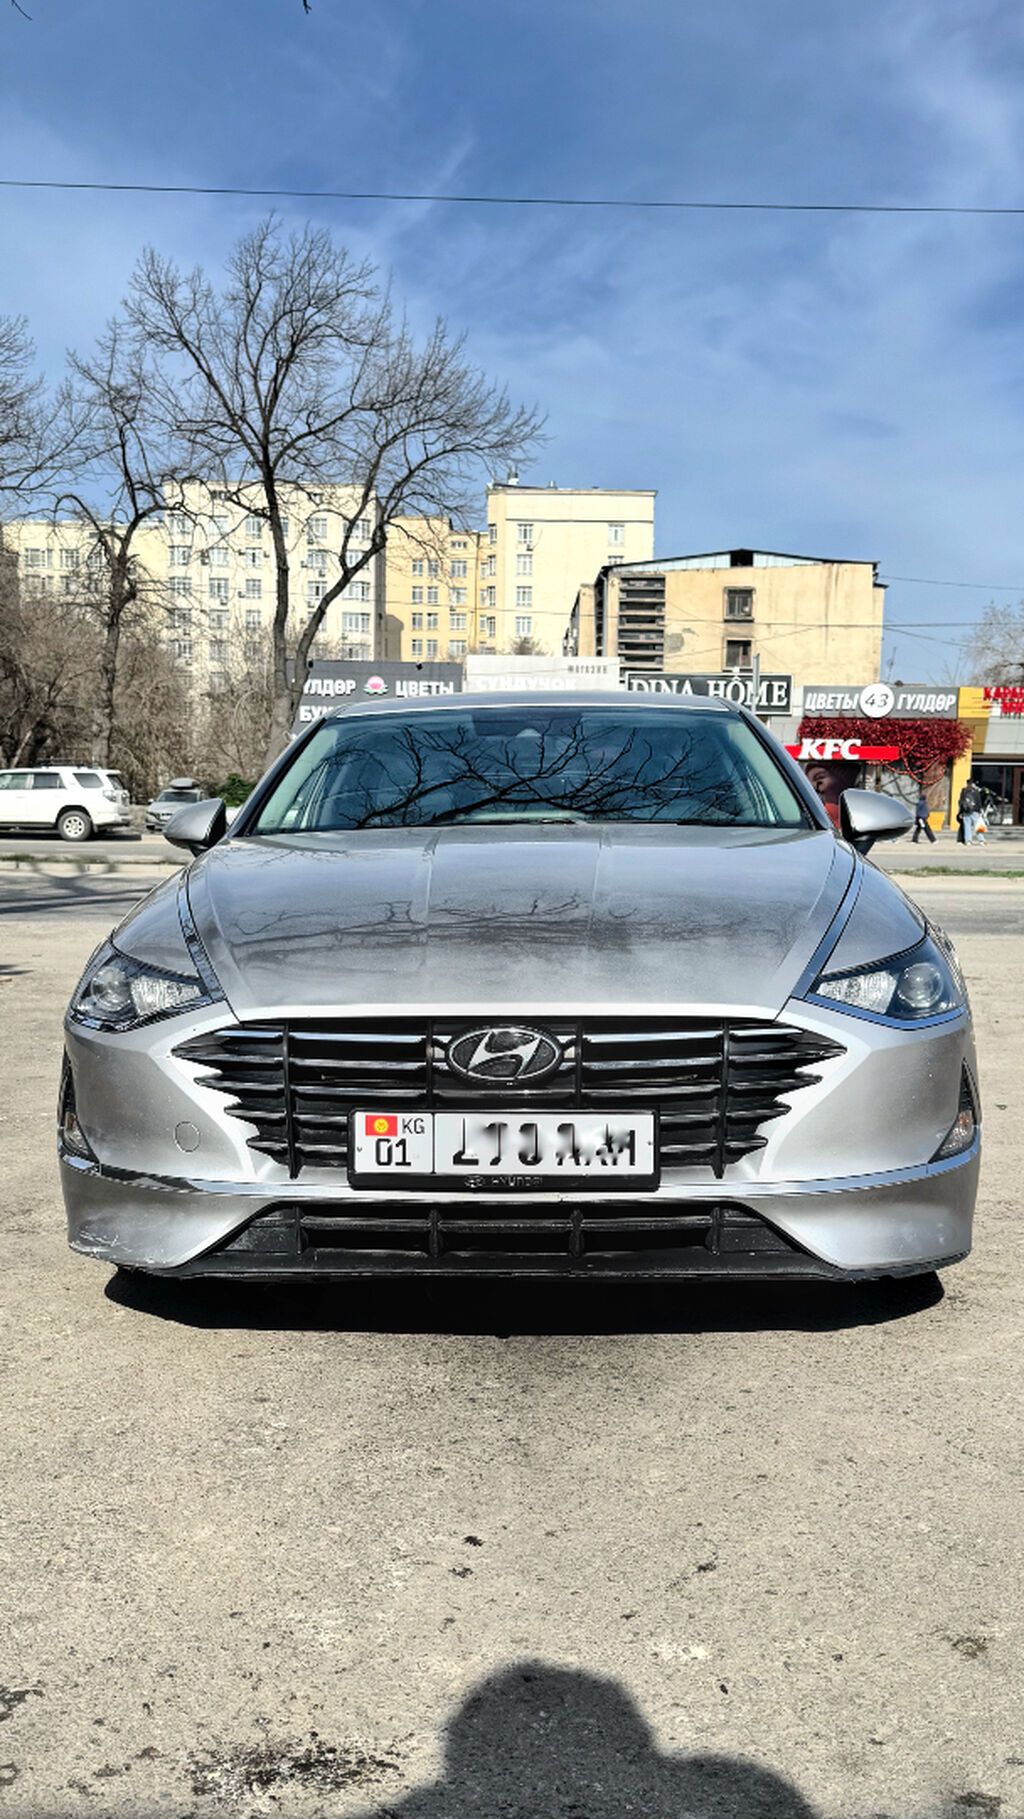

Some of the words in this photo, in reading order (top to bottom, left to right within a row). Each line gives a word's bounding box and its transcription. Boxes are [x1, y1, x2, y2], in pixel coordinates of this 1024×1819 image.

[395, 680, 455, 697] ЦВЕТЫ
[630, 679, 694, 695] DINA
[804, 693, 860, 711] ЦВЕТЫ
[865, 693, 889, 708] 43
[896, 693, 957, 712] ГҮЛДӨР
[798, 738, 862, 760] KFC
[402, 1118, 425, 1134] KG
[375, 1138, 411, 1166] 01
